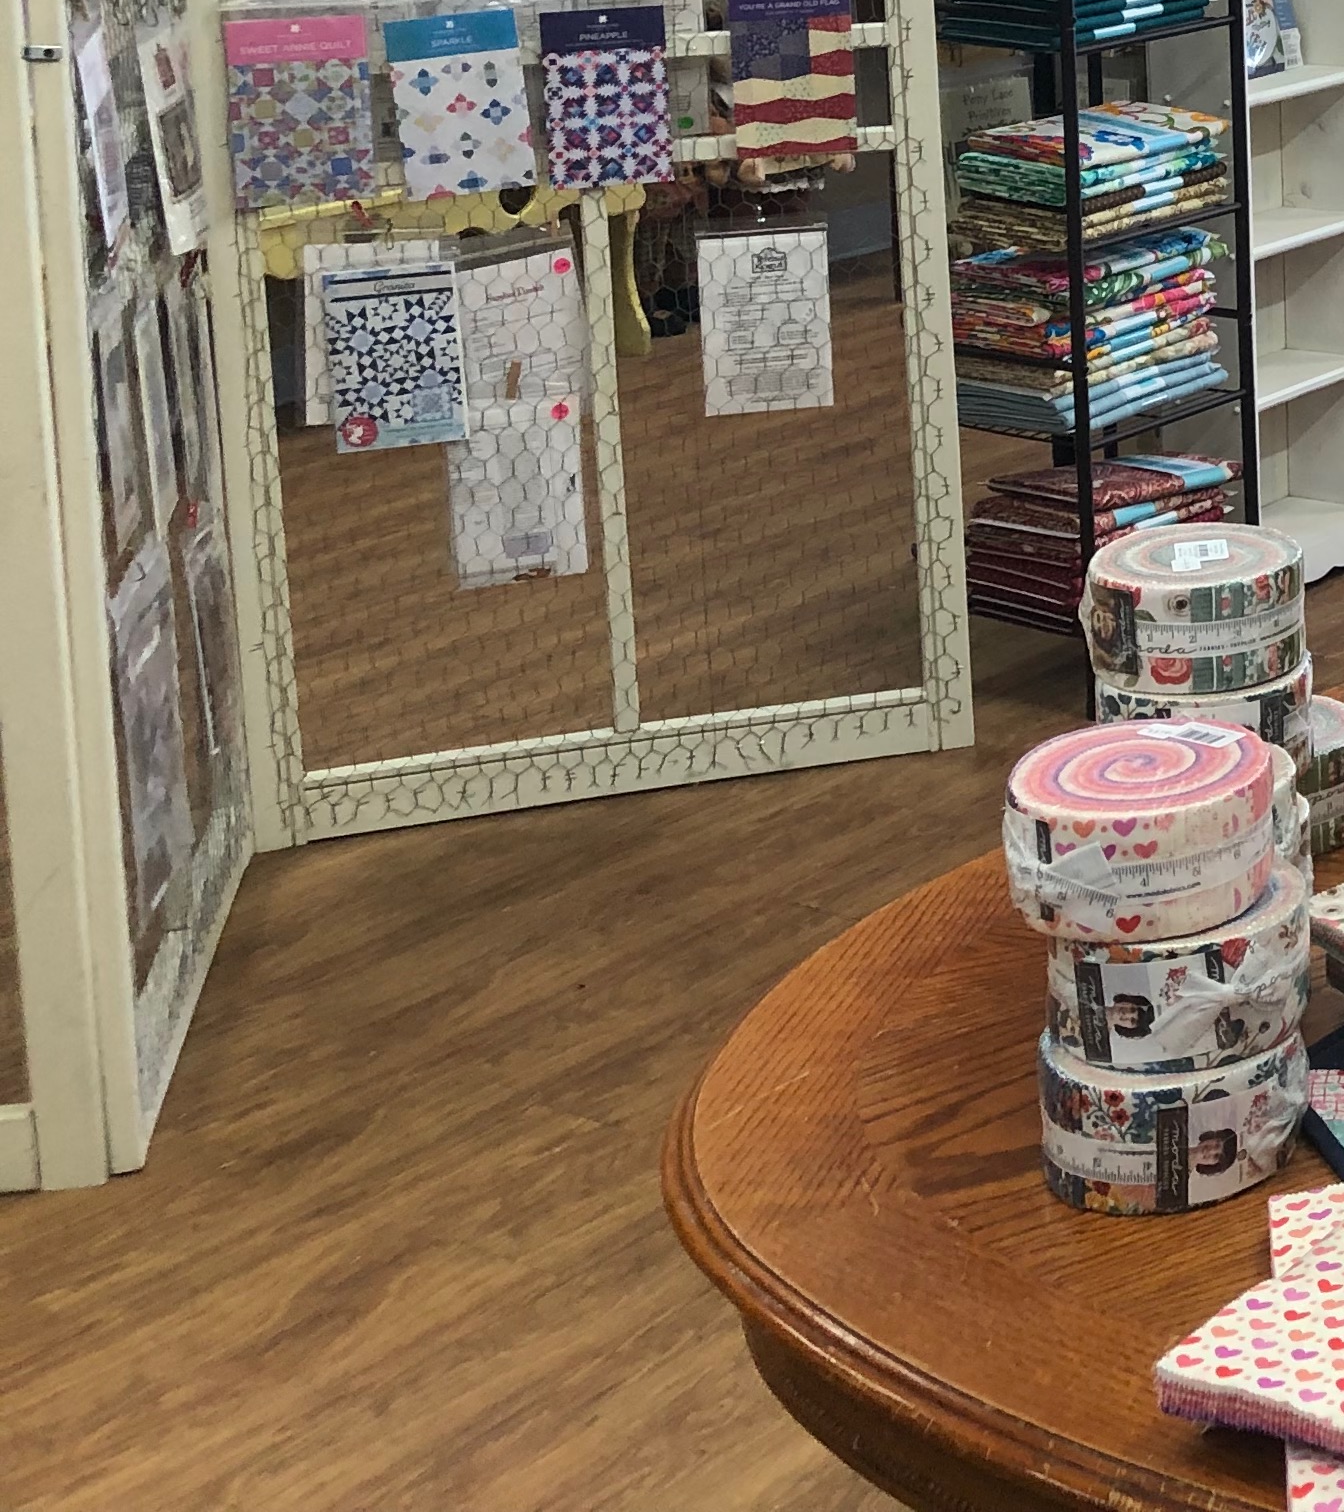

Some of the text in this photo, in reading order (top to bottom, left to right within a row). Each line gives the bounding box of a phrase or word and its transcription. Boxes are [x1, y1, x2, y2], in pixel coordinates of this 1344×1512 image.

[431, 35, 473, 47] SPARKLE
[580, 31, 628, 41] PINEAPPLE
[240, 40, 352, 55] SWEET ANNIE QUILT
[1172, 1120, 1182, 1195] moda
